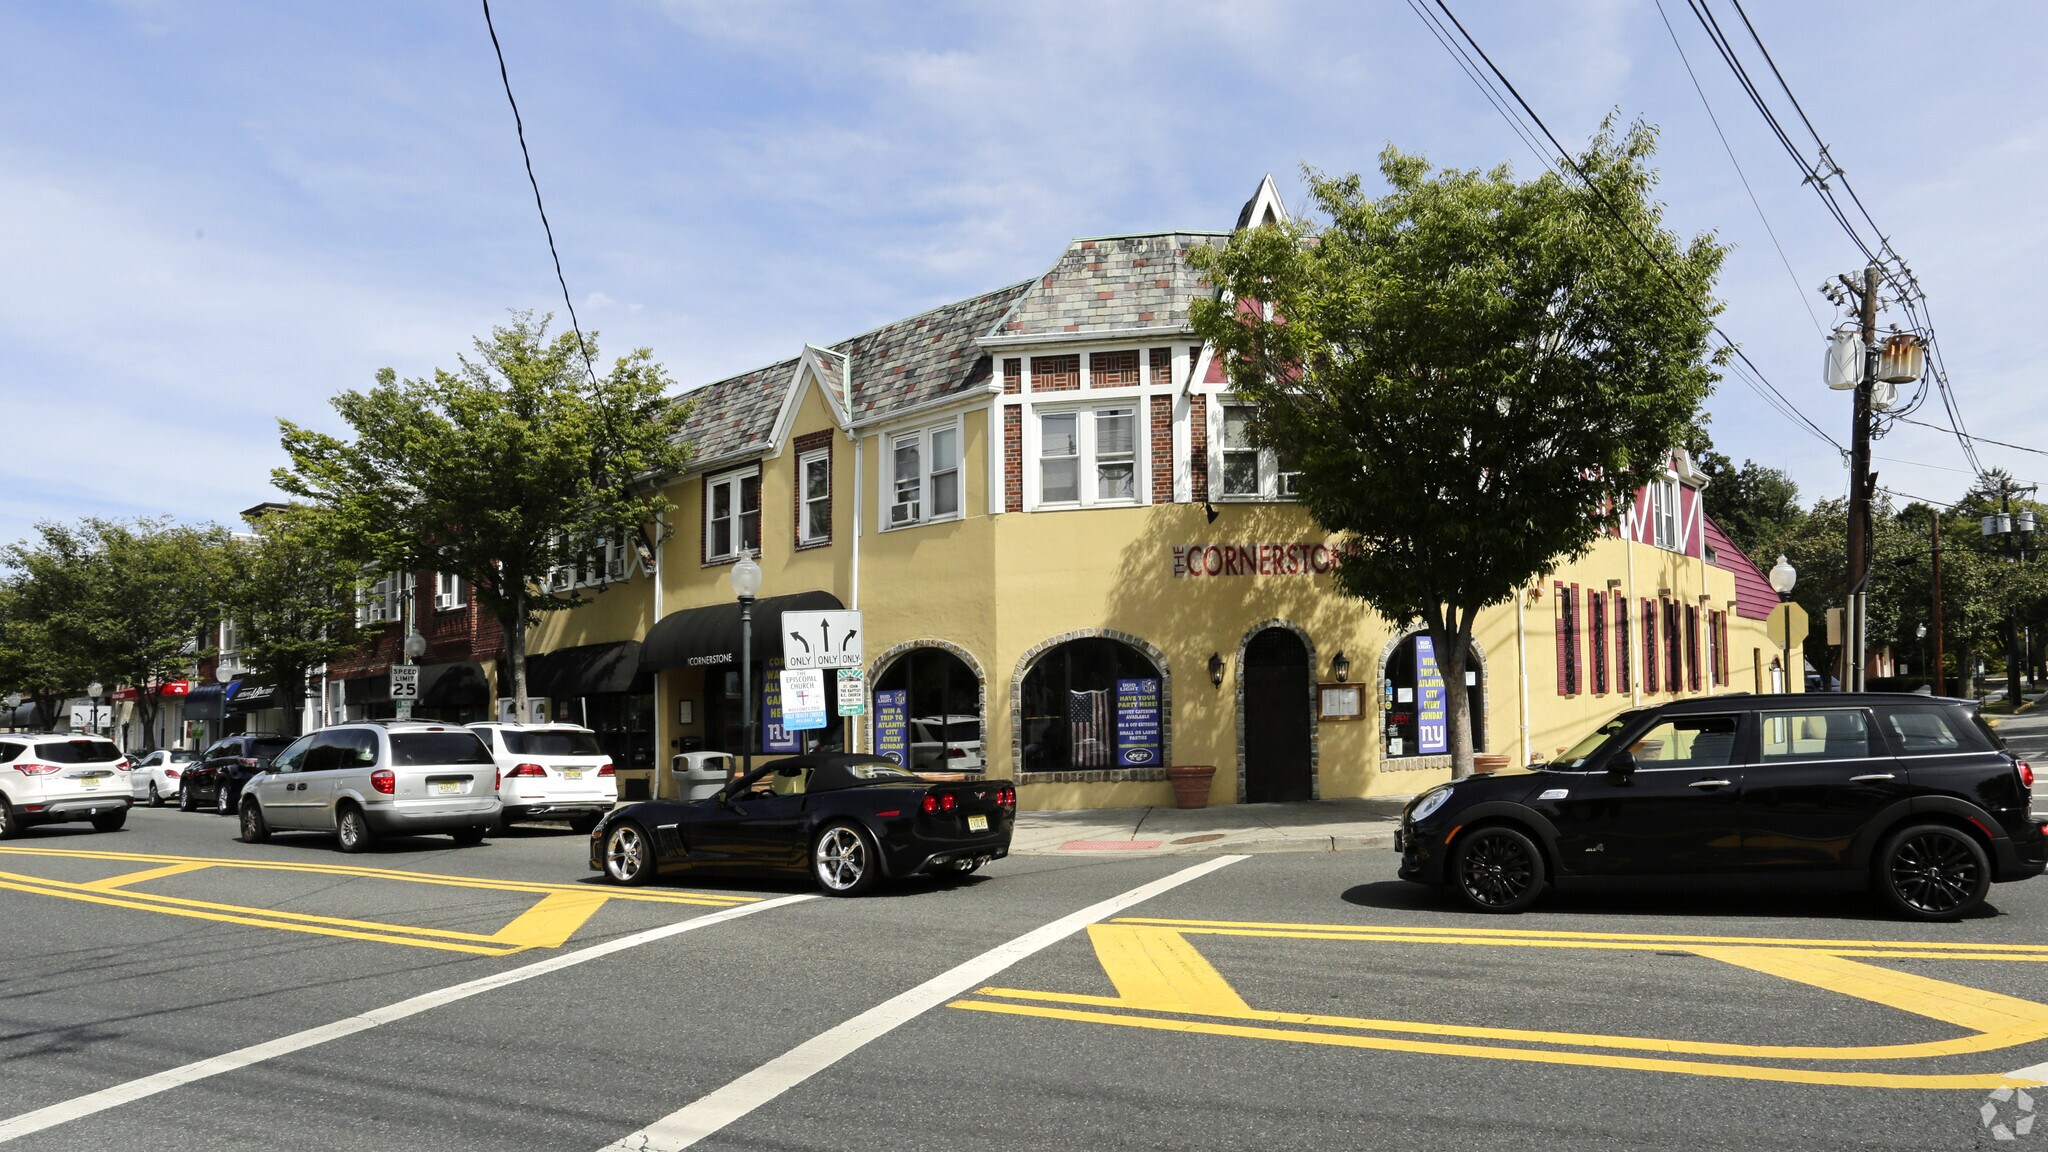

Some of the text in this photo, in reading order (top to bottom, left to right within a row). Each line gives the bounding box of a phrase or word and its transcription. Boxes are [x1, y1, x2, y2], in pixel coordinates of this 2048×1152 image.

[1173, 546, 1185, 577] THE
[690, 653, 732, 666] CORNERSTONE
[790, 654, 860, 666] ONLY ONLY ONLY
[1422, 658, 1434, 666] WIN
[1420, 668, 1433, 677] TRIP
[785, 675, 817, 684] EPISCOPAL
[393, 683, 416, 696] 25
[790, 682, 815, 690] CHURCH
[1425, 689, 1439, 699] CITY
[1423, 700, 1441, 710] EVERY
[1420, 711, 1444, 721] SUNDAY
